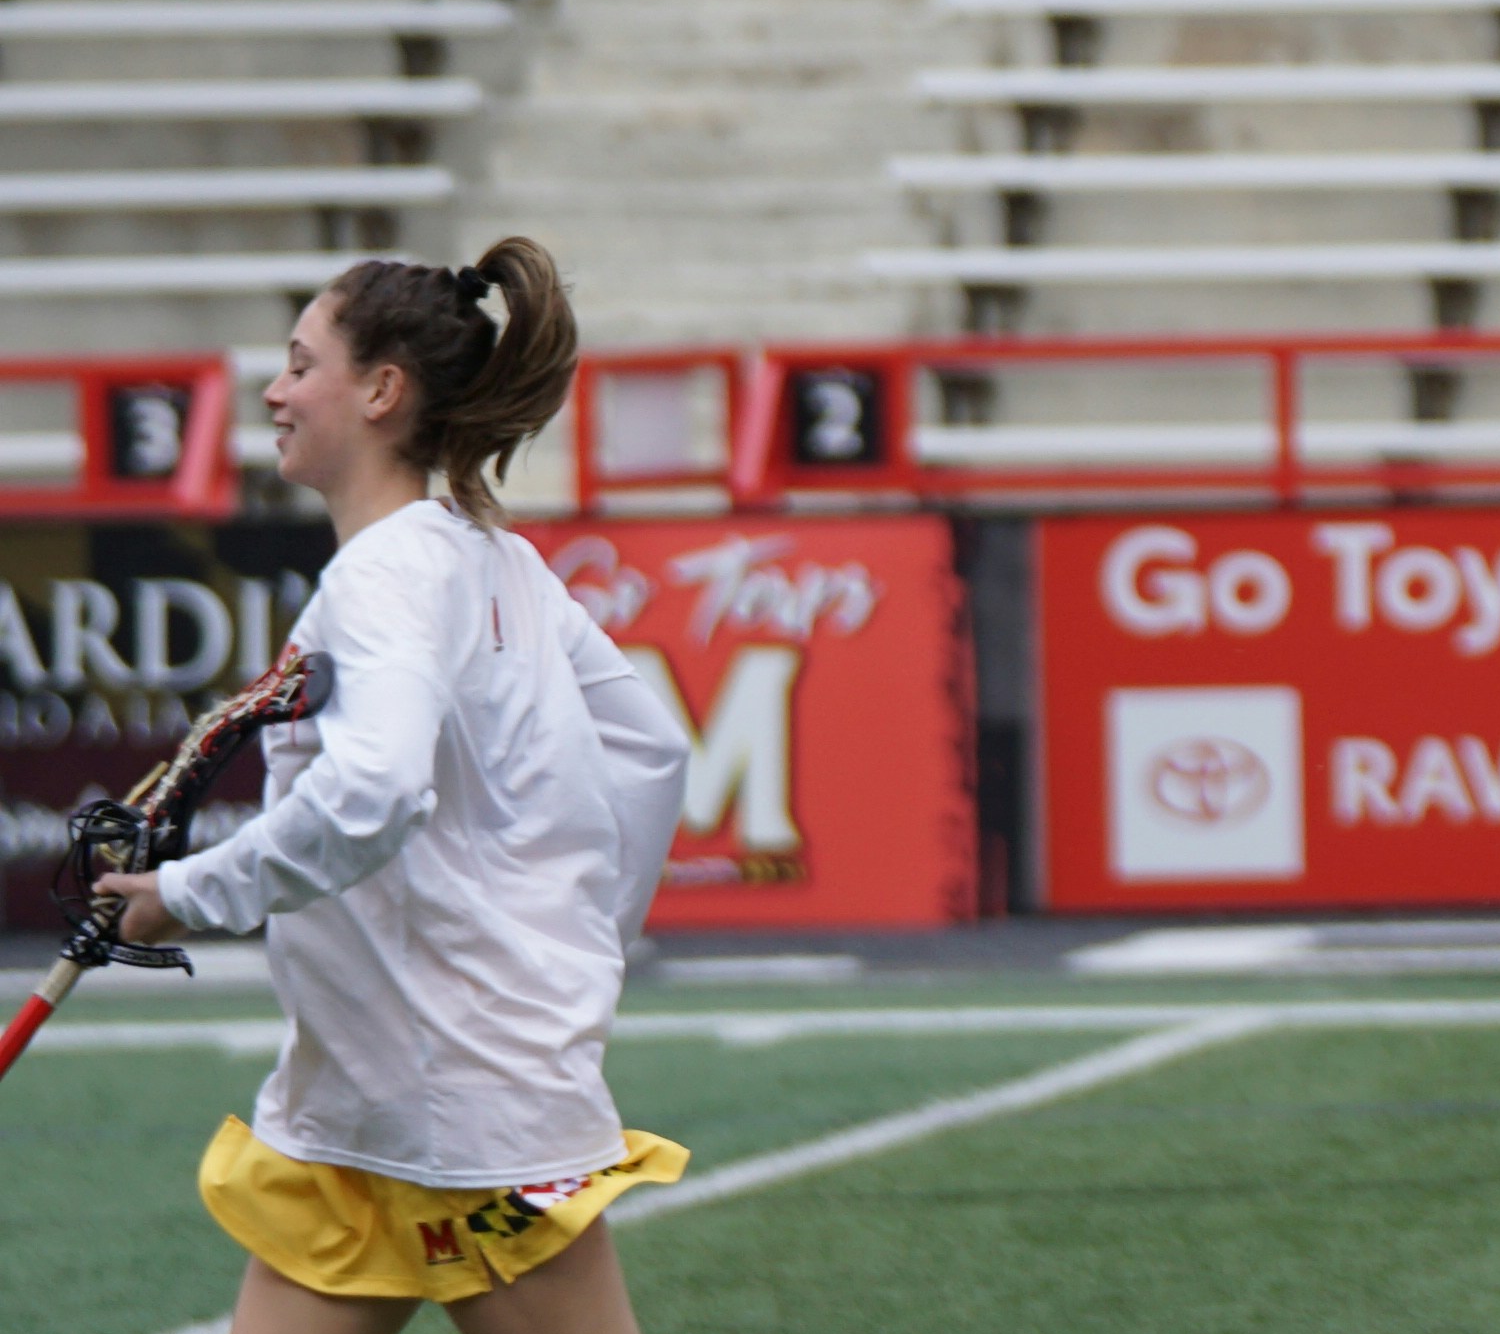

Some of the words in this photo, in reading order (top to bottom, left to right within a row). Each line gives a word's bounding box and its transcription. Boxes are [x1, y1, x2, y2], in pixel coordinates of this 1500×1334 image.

[126, 397, 180, 475] 3
[803, 381, 864, 456] 2
[1100, 524, 1293, 635] Go
[624, 645, 802, 849] M
[416, 1219, 464, 1260] M
